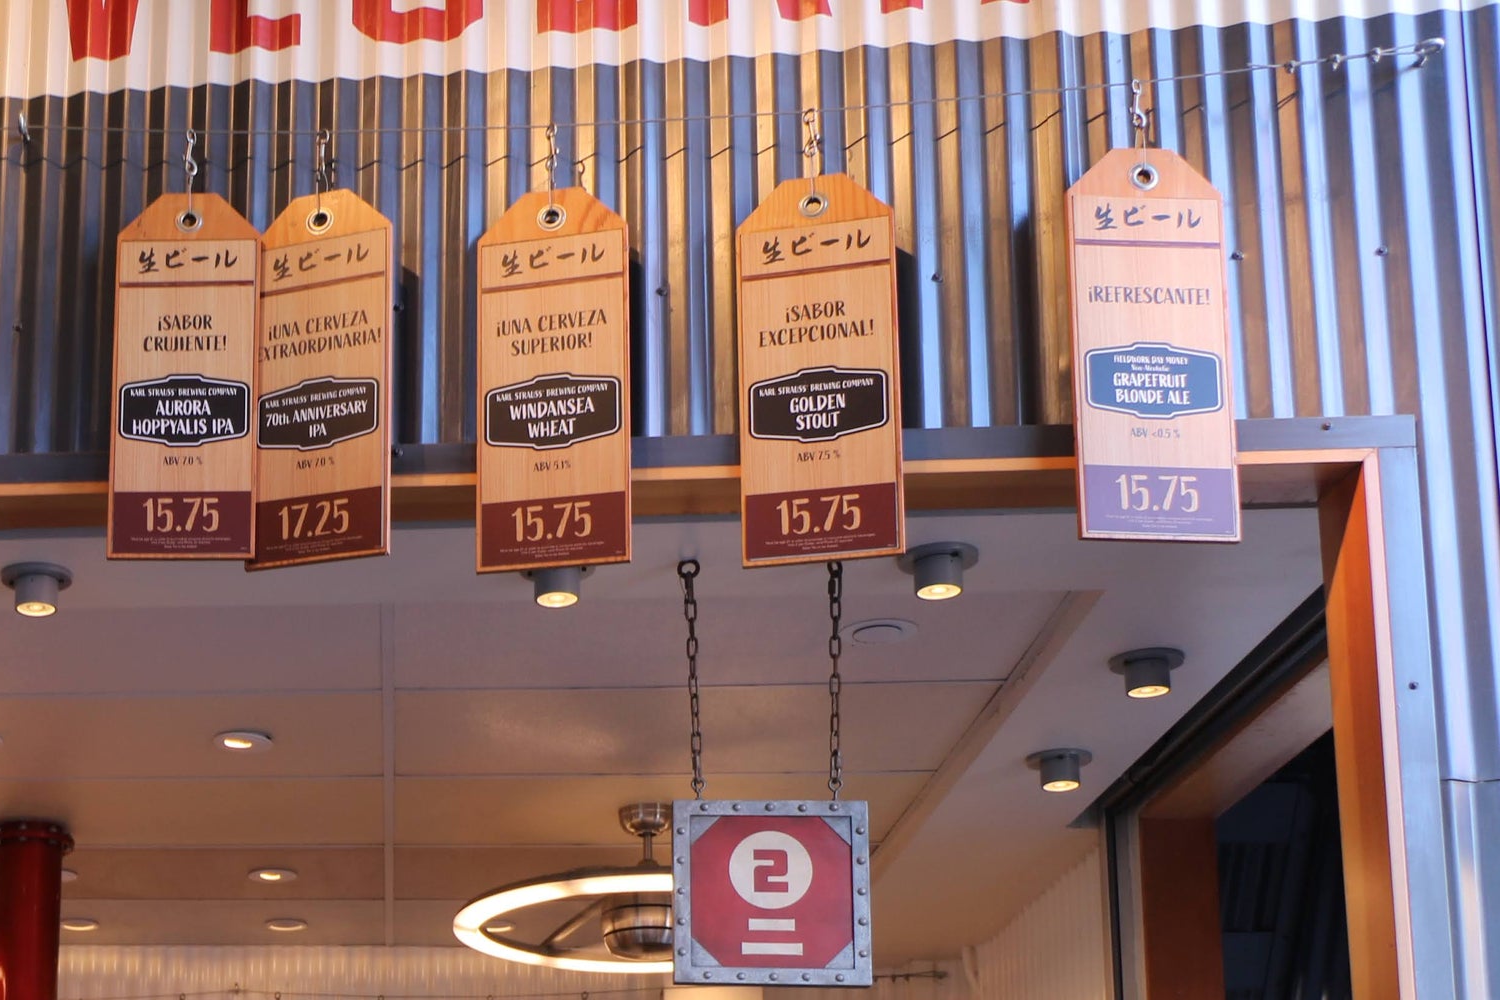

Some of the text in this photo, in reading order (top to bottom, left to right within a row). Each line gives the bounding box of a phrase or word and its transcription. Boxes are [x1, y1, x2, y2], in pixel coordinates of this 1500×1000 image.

[1093, 204, 1201, 231] 生ビール
[761, 228, 871, 266] 生ビール
[137, 247, 238, 275] 生ビール
[272, 243, 370, 283] 生ビール
[500, 242, 606, 278] 生ビール
[1088, 285, 1210, 306] ¡REFRESCANTE!
[785, 300, 846, 323] ¡SABOR
[157, 314, 213, 332] ¡SABOR
[268, 309, 369, 342] ¡UNA CERVEZA
[496, 308, 607, 338] ¡UNA CERVEZA
[759, 318, 875, 348] EXCEPCIONAL!
[143, 335, 227, 353] CRUJIENTE!
[511, 332, 593, 357] SUPERIOR!
[1113, 355, 1188, 366] FIELDWORK DAY MONEY
[759, 386, 776, 397] KARL
[809, 381, 841, 392] BREWING
[842, 377, 874, 389] COMPANY
[1113, 372, 1187, 388] GRAPEFRUIT
[130, 388, 146, 397] KARL
[178, 388, 207, 397] BREWING
[208, 387, 238, 397] COMPANY
[265, 399, 281, 410] KARL
[310, 390, 338, 403] BREWING
[338, 386, 367, 398] COMPANY
[496, 391, 513, 402] KARL
[546, 385, 577, 398] BREWING
[577, 382, 609, 395] COMPANY
[789, 393, 846, 413] GOLDEN
[1115, 388, 1191, 405] BLONDE ALE
[155, 399, 212, 416] AURORA
[265, 400, 369, 428] 70th ANNIVERSARY
[509, 396, 595, 421] WINDANSEA
[132, 417, 235, 436] HOPPYALIS IPA
[308, 423, 328, 439] IPA
[527, 417, 577, 439] WHEAT
[795, 411, 840, 431] STOUT
[1130, 427, 1148, 438] ABV
[1151, 428, 1171, 438] <0.5
[162, 455, 180, 466] ABV
[296, 458, 312, 470] ABV
[533, 460, 551, 472] ABV
[797, 451, 814, 462] ABV
[1115, 474, 1199, 513] 15.75
[142, 497, 220, 533] 15.75
[278, 498, 349, 541] 17.25
[511, 501, 593, 543] 15.75
[776, 493, 861, 536] 15.75
[753, 849, 789, 893] 2
